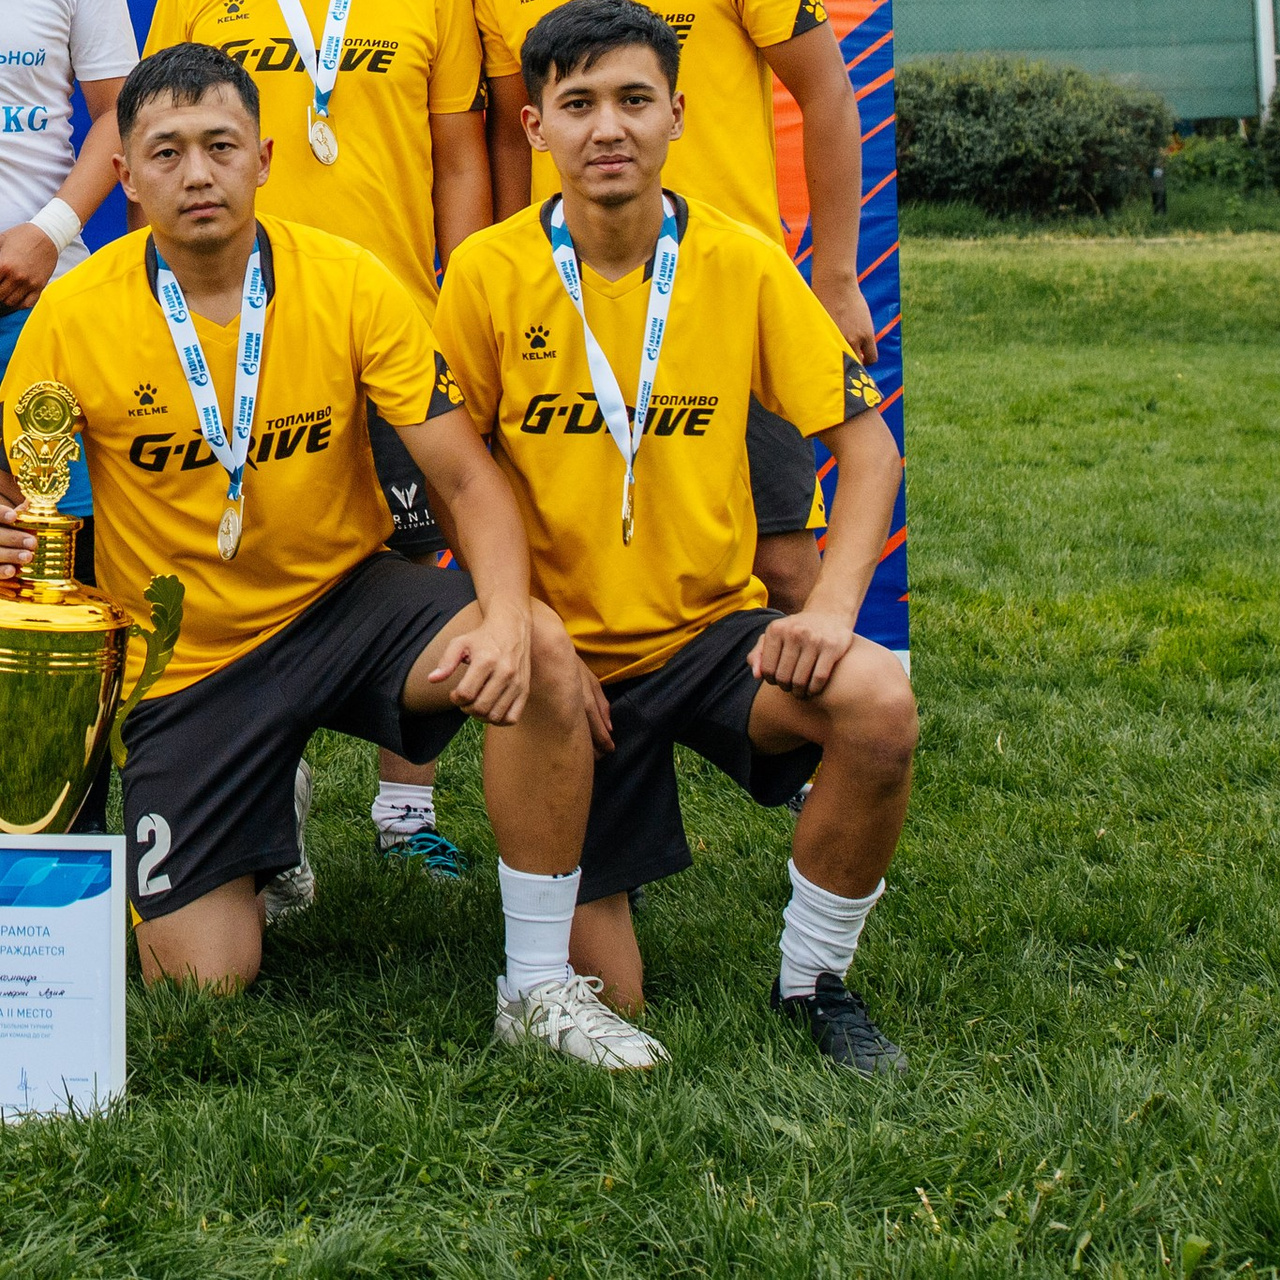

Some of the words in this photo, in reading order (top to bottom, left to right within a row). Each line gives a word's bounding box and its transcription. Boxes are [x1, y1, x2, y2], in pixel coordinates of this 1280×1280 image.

[217, 13, 250, 24] KELME
[342, 38, 399, 50] ОПЛИВО
[659, 252, 669, 281] ГАЗПРОМ
[250, 267, 260, 295] ГАЗПРОМ
[245, 332, 254, 362] ГАЗПРОМ
[521, 350, 557, 361] KELME
[183, 346, 199, 376] ГАЗПРОМ
[128, 406, 169, 417] KELME
[239, 396, 248, 425] ГАЗПРОМ
[650, 395, 719, 407] ТОПЛИВО
[202, 406, 214, 437] ГАЗПРОМ
[265, 405, 332, 431] ТОПЛИВО
[136, 812, 172, 897] 2
[16, 1008, 53, 1019] МЕСТО
